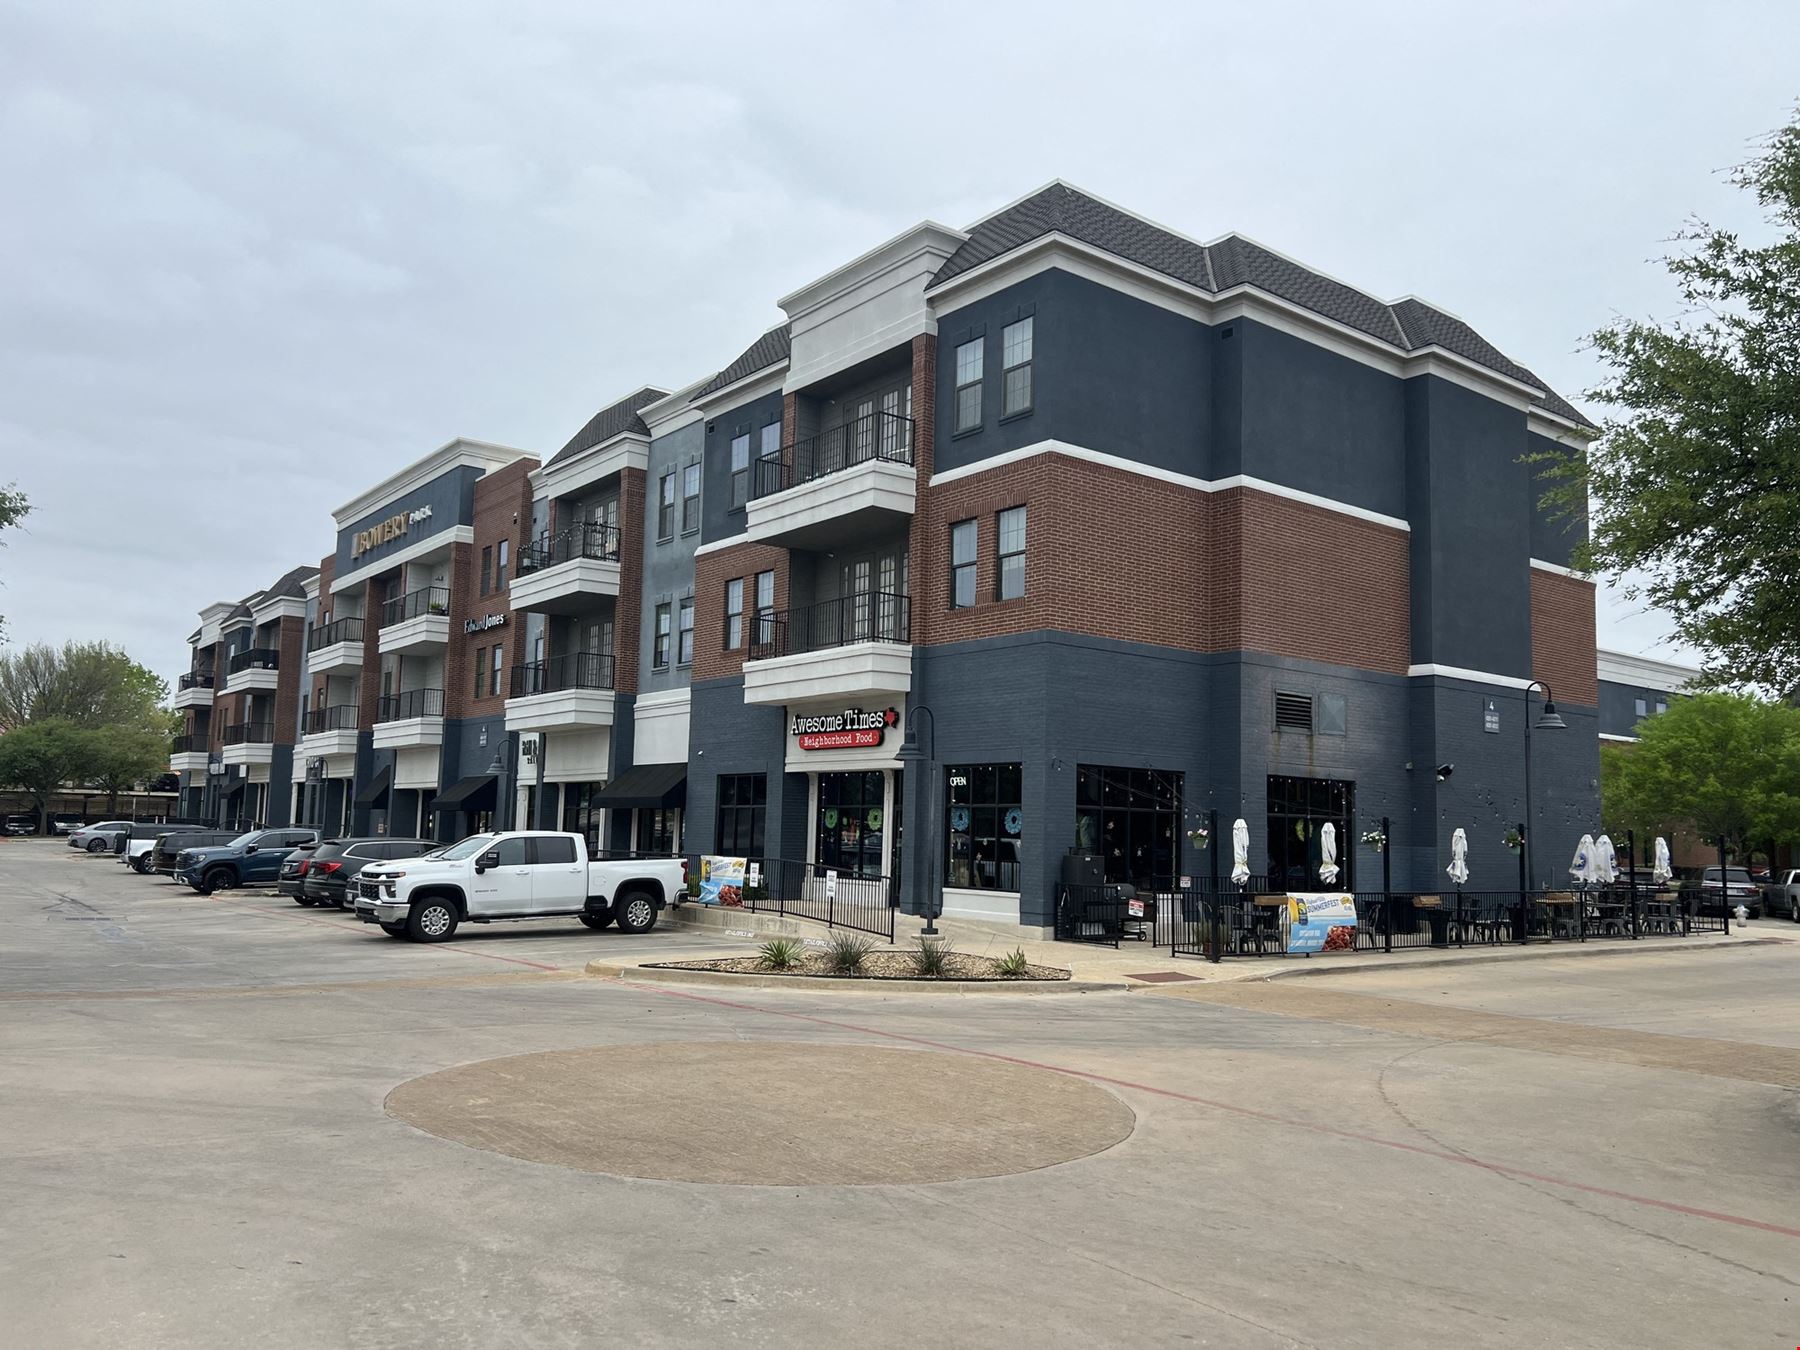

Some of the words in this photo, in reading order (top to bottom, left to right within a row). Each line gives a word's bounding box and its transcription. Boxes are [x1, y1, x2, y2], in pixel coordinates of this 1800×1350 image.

[359, 511, 410, 553] BOWERY
[485, 613, 504, 630] Jones
[790, 714, 843, 734] Awesome
[844, 709, 884, 730] Times
[804, 734, 852, 748] Neighborhood
[855, 732, 873, 743] Food
[949, 776, 967, 786] OPEN
